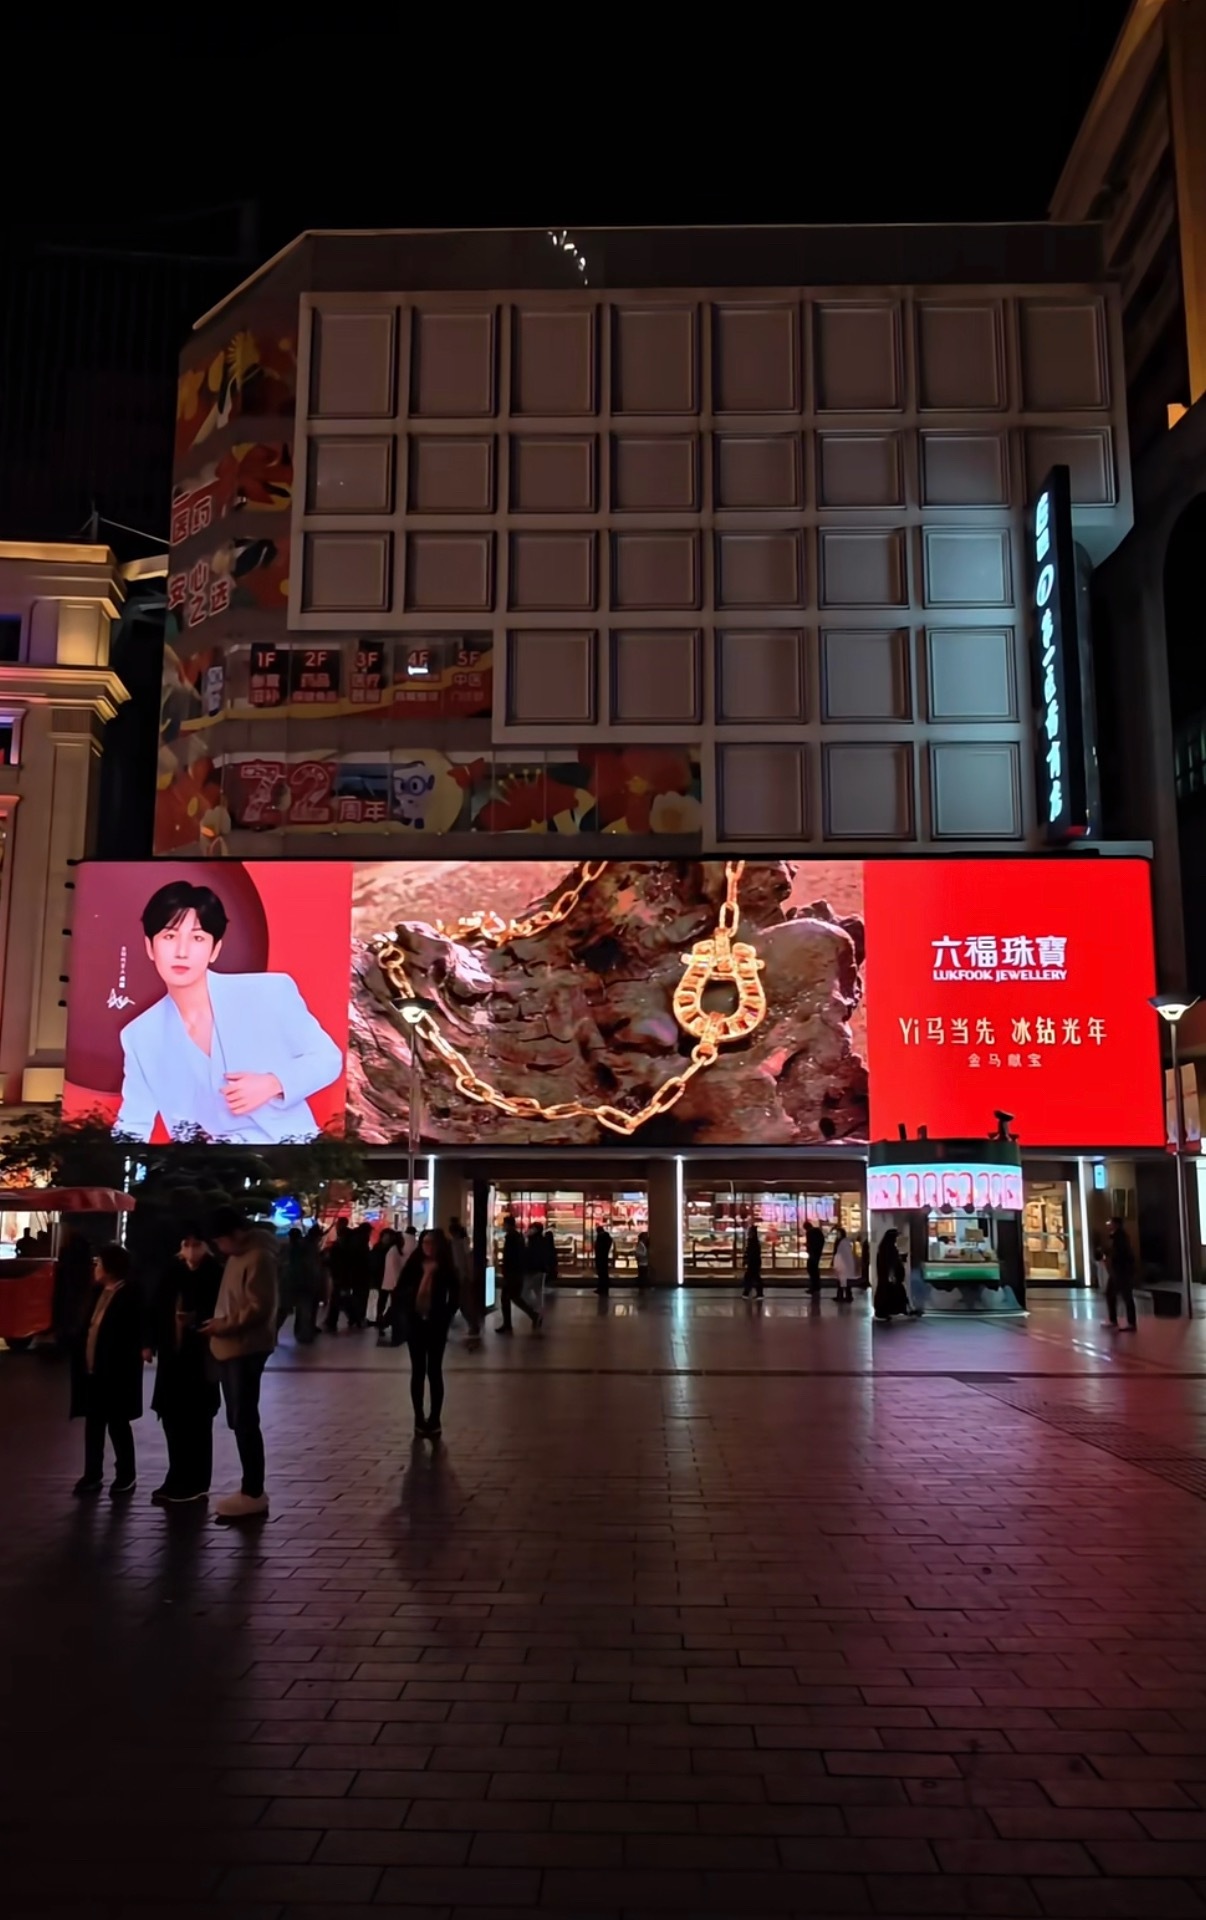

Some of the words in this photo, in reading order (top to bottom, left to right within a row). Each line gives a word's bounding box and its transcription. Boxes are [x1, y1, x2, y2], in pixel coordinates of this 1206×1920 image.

[167, 560, 231, 627] 安心之选
[257, 651, 276, 668] 1F
[304, 651, 328, 667] 2F
[356, 651, 379, 667] 3F
[408, 651, 430, 667] 4F
[457, 651, 481, 666] 5F
[454, 673, 483, 688] 中医
[240, 760, 331, 823] 72
[338, 800, 388, 822] 周年
[931, 935, 1068, 968] 六福珠寶
[932, 969, 994, 981] LUKFOOK
[995, 969, 1068, 982] JEWELLERY
[898, 1016, 996, 1046] Yi马当先
[1011, 1016, 1108, 1046] 冰钻光年
